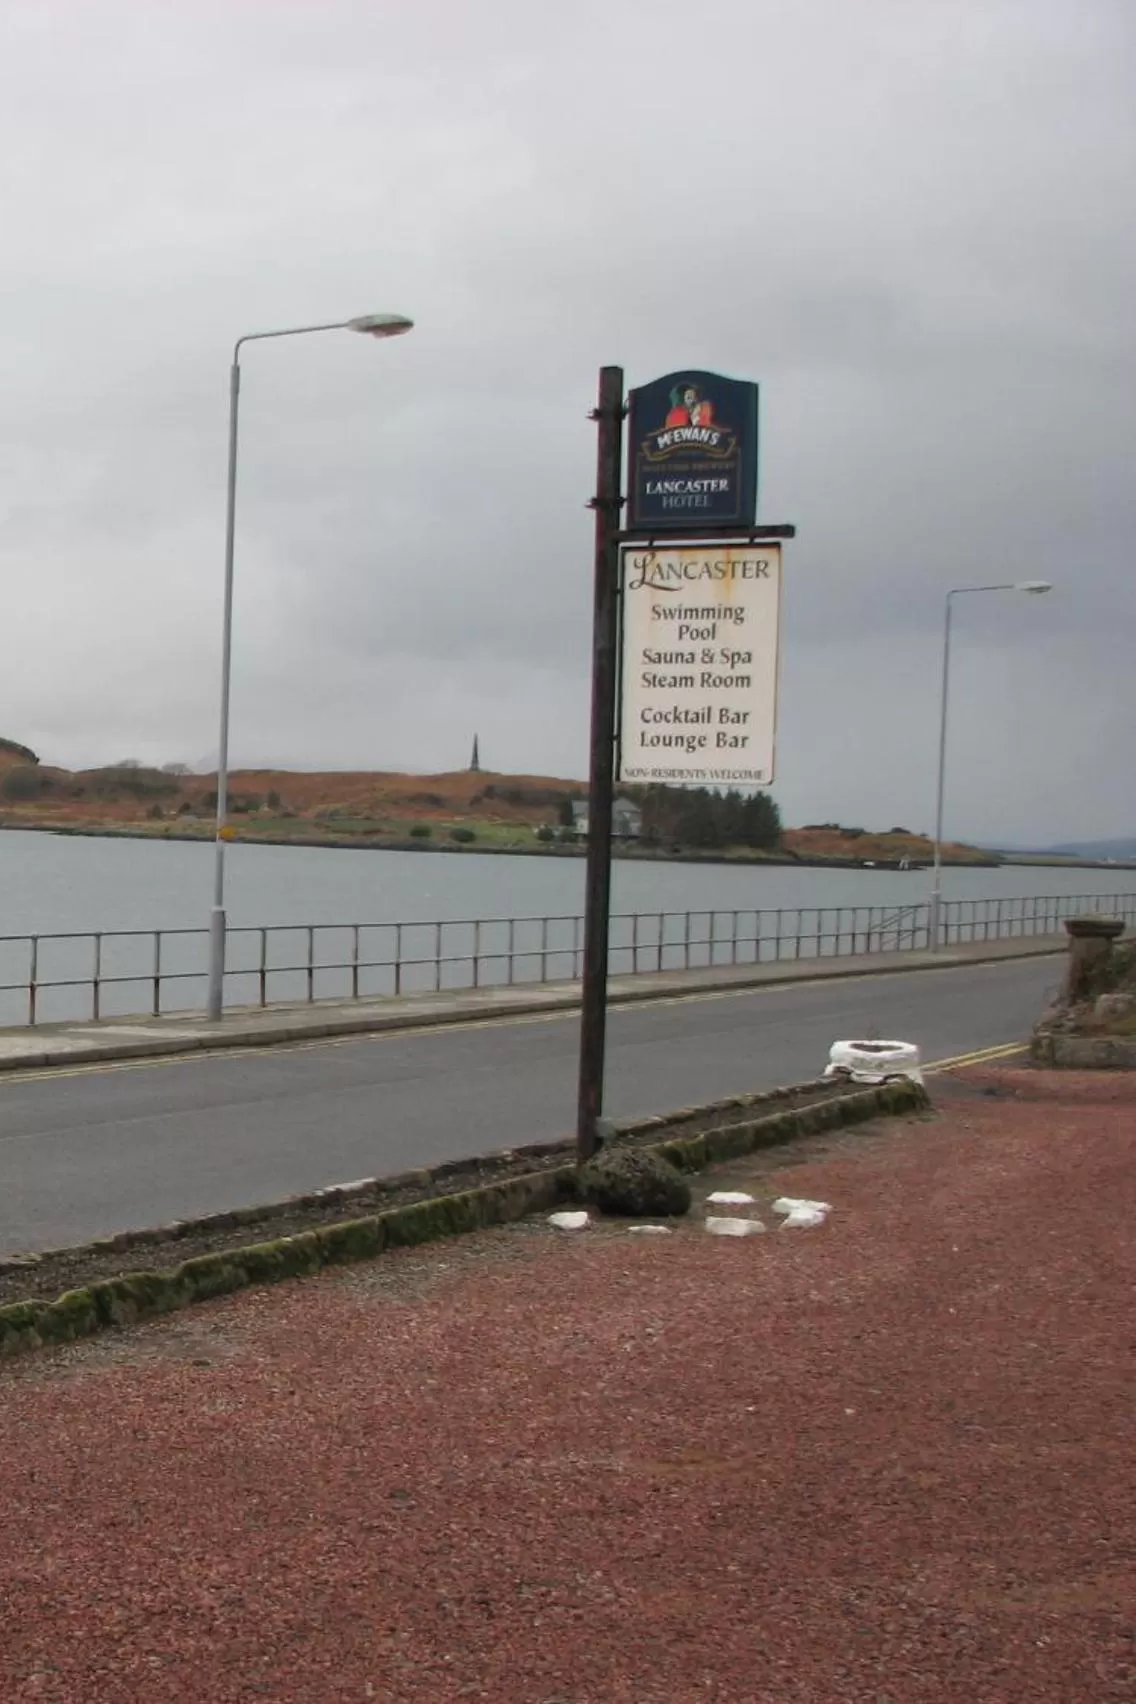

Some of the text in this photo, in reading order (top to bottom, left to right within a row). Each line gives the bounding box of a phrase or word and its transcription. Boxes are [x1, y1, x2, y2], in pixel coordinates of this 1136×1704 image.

[646, 479, 729, 495] LANCASTER
[662, 494, 713, 508] HOTEL
[629, 552, 770, 591] LANCASTER
[651, 602, 745, 625] Swimming
[678, 623, 717, 641] Pool
[642, 647, 752, 669] Sauna & Spa
[641, 671, 752, 688] Steam Room
[640, 705, 750, 725] Cocktail Bar
[640, 730, 749, 753] Lounge Bar
[624, 768, 763, 781] NON-RESIDENTS WELCOME
